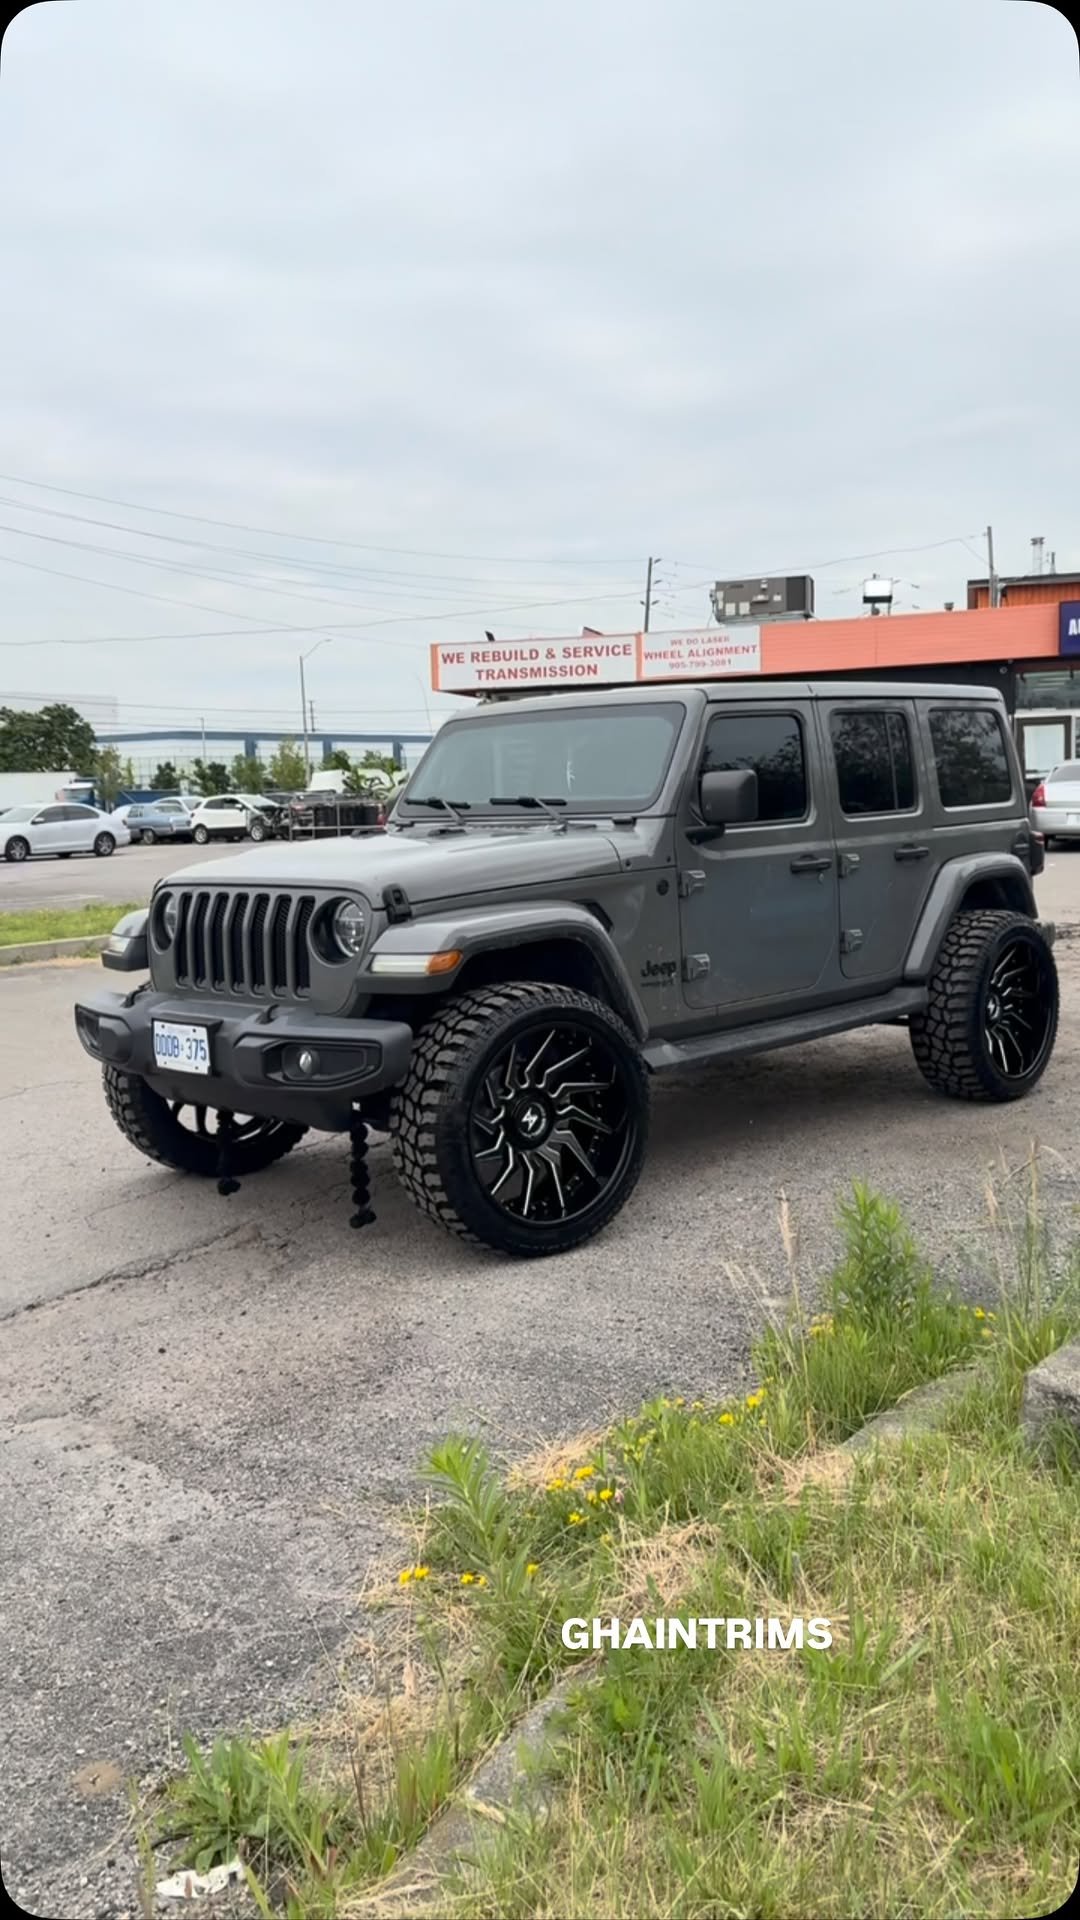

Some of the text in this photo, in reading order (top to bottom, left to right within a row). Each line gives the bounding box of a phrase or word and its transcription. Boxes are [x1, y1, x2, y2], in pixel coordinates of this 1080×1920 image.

[442, 643, 632, 664] WE REBUILD & SERVICE
[644, 644, 757, 660] WHEEL ALIGNMENT
[476, 664, 598, 681] TRANSMISSION
[641, 960, 677, 977] Jeep
